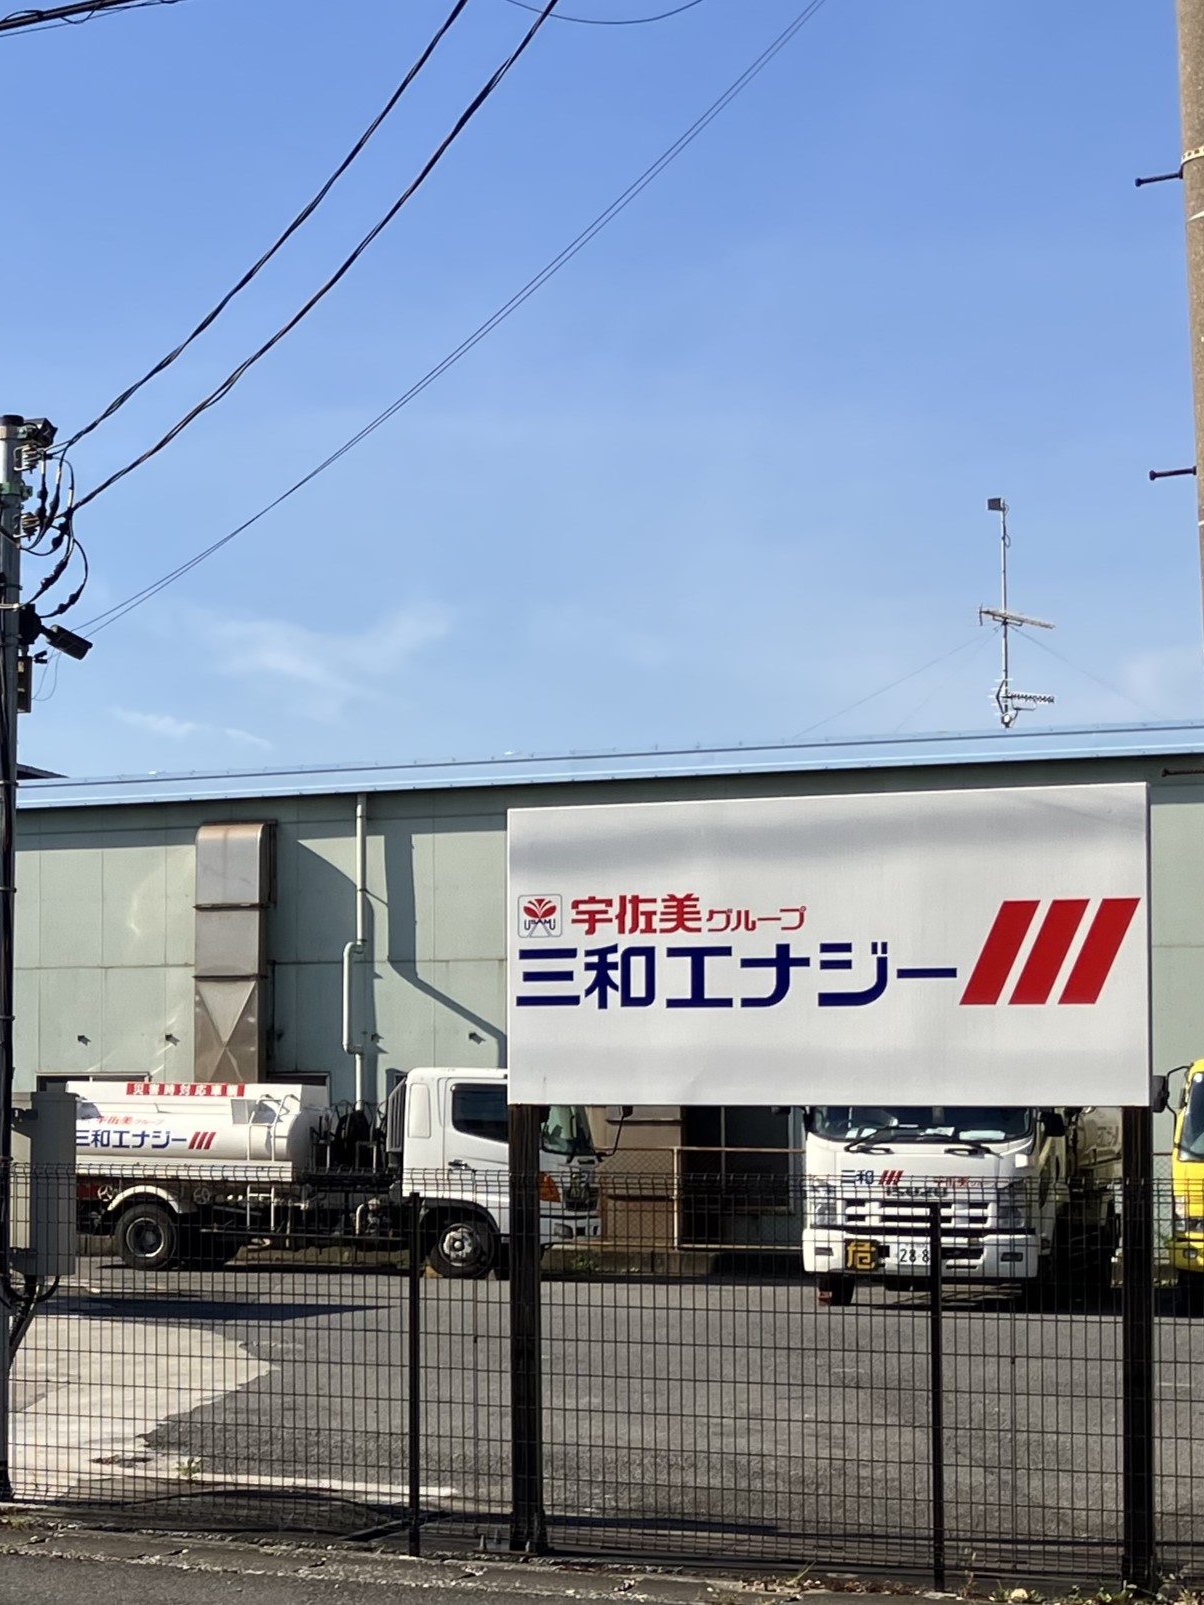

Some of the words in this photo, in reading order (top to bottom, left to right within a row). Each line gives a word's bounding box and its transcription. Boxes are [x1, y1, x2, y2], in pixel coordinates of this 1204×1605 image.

[571, 893, 807, 936] 宇佐美グループ
[516, 941, 958, 1010] 三和エナジー
[76, 1129, 187, 1149] 三和エナジー
[842, 1169, 874, 1184] 三和
[847, 1242, 877, 1269] 危
[900, 1248, 931, 1263] 28-8
